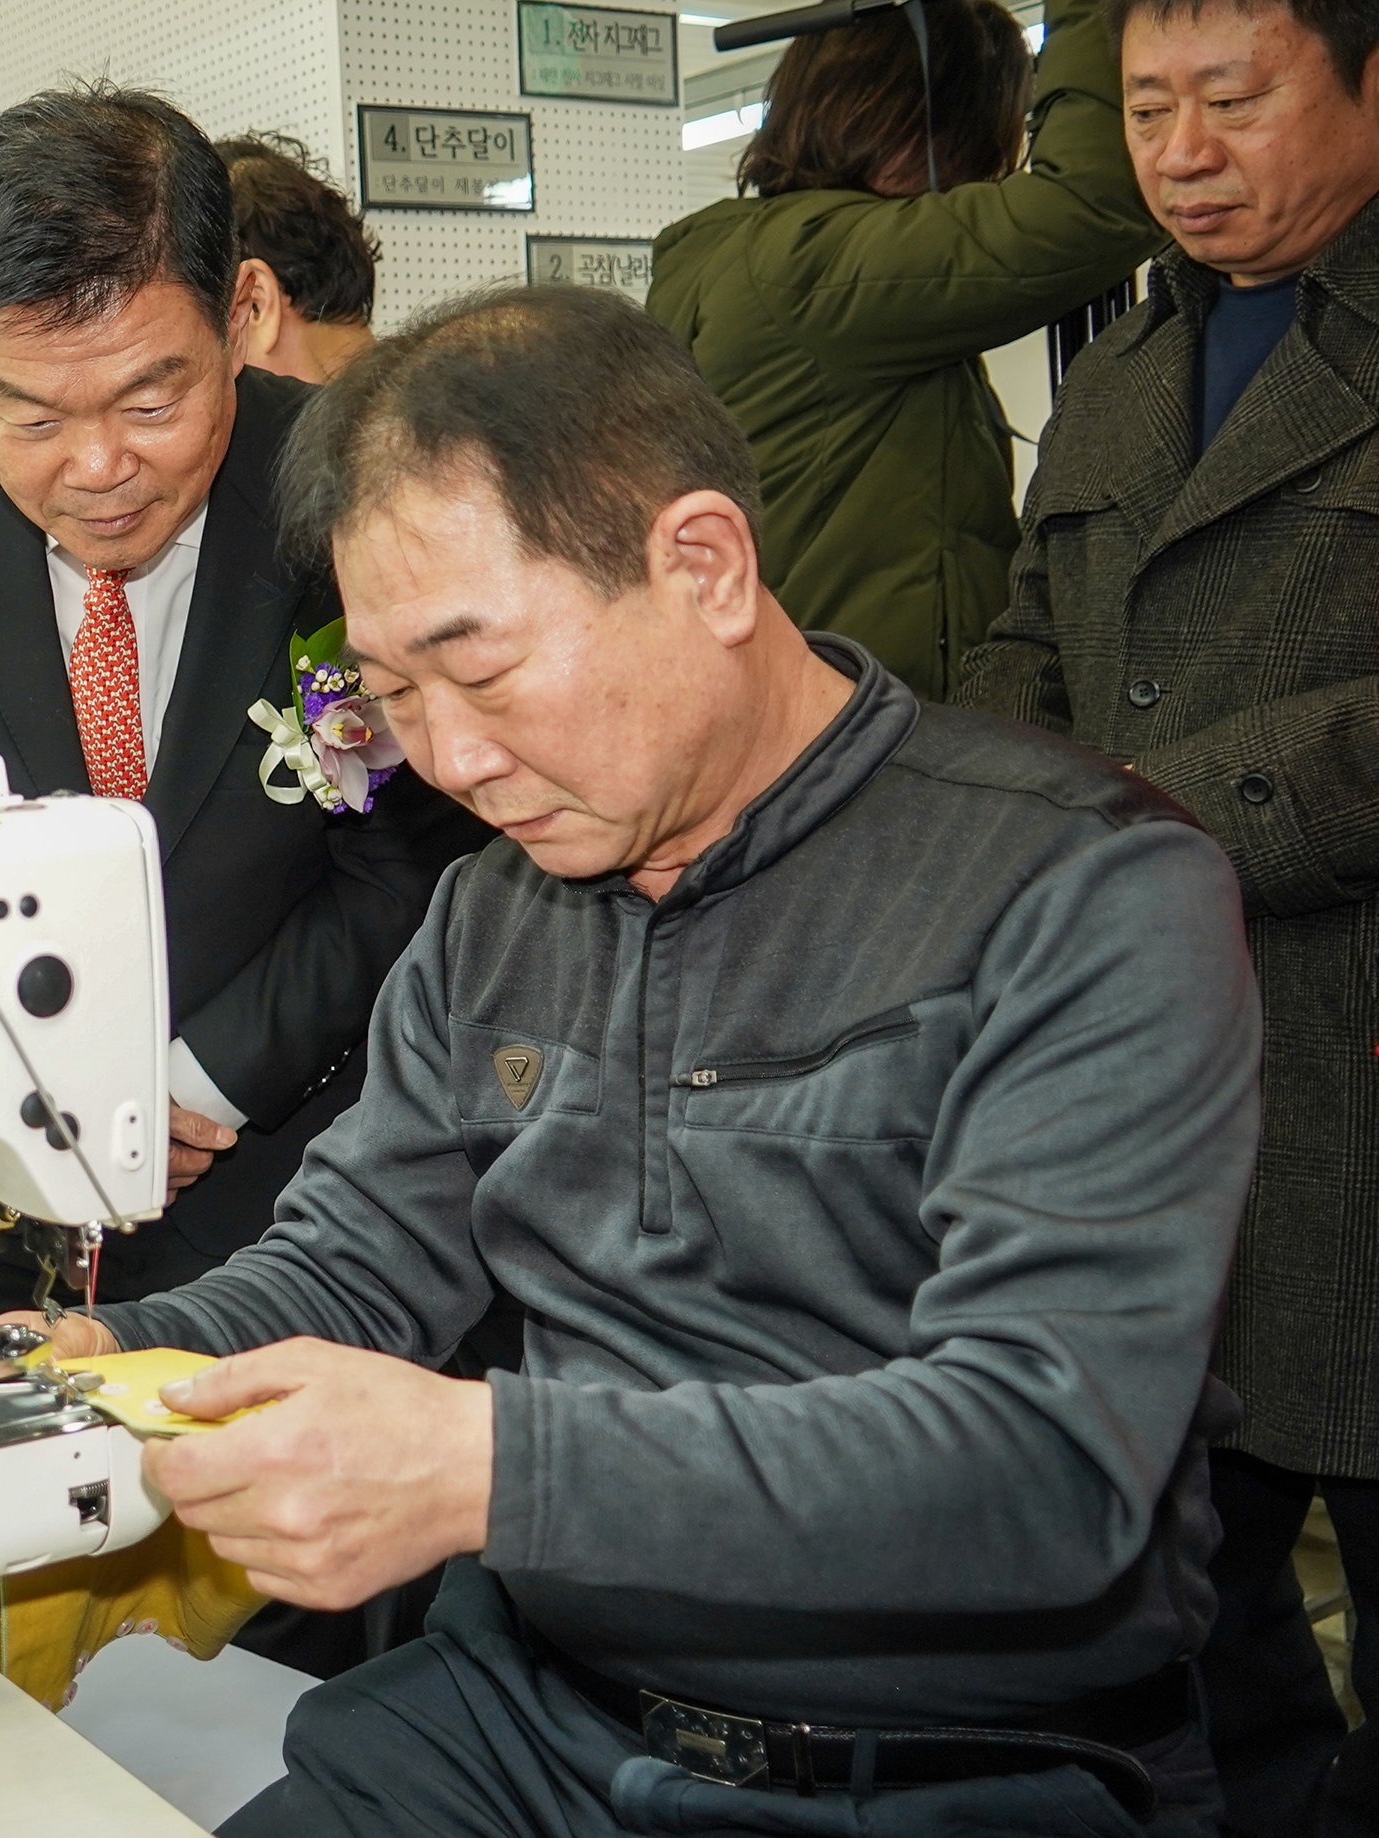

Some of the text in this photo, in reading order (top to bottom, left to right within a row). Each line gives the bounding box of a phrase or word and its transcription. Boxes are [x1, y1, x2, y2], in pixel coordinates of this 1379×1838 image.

[543, 18, 664, 56] 1. 전자 지그재그
[383, 123, 516, 162] 4. 단추달이
[549, 253, 570, 280] 2.
